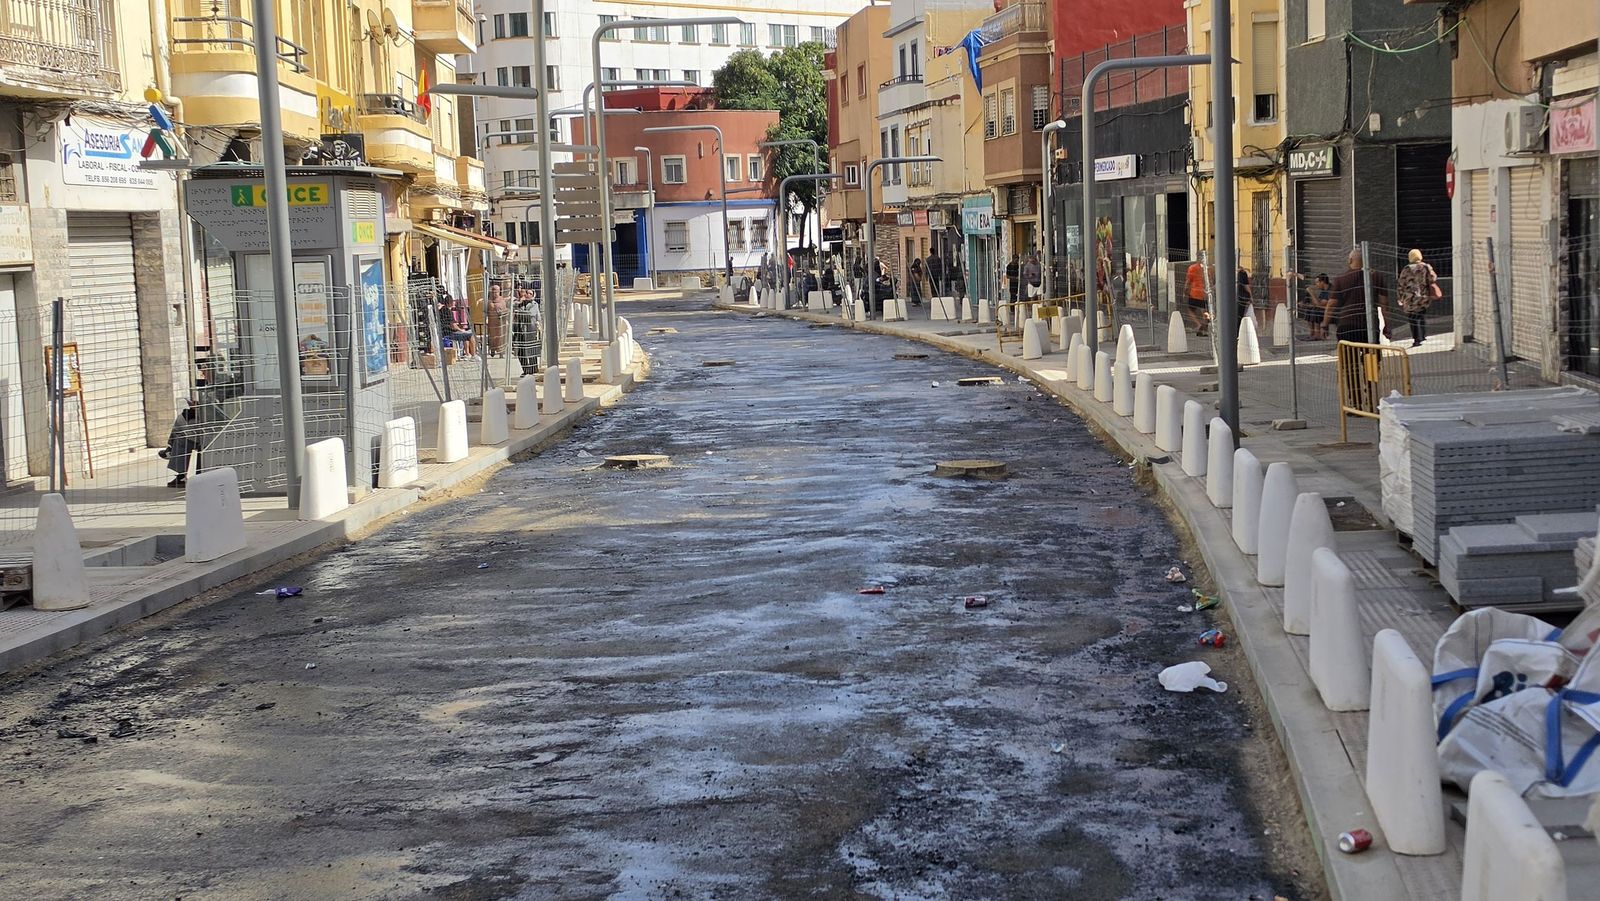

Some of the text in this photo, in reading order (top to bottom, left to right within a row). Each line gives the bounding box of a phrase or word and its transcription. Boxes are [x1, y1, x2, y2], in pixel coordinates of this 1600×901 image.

[78, 160, 105, 171] LABORAL
[108, 162, 128, 173] FISCAL
[260, 186, 321, 203] CE
[979, 213, 991, 229] ERA
